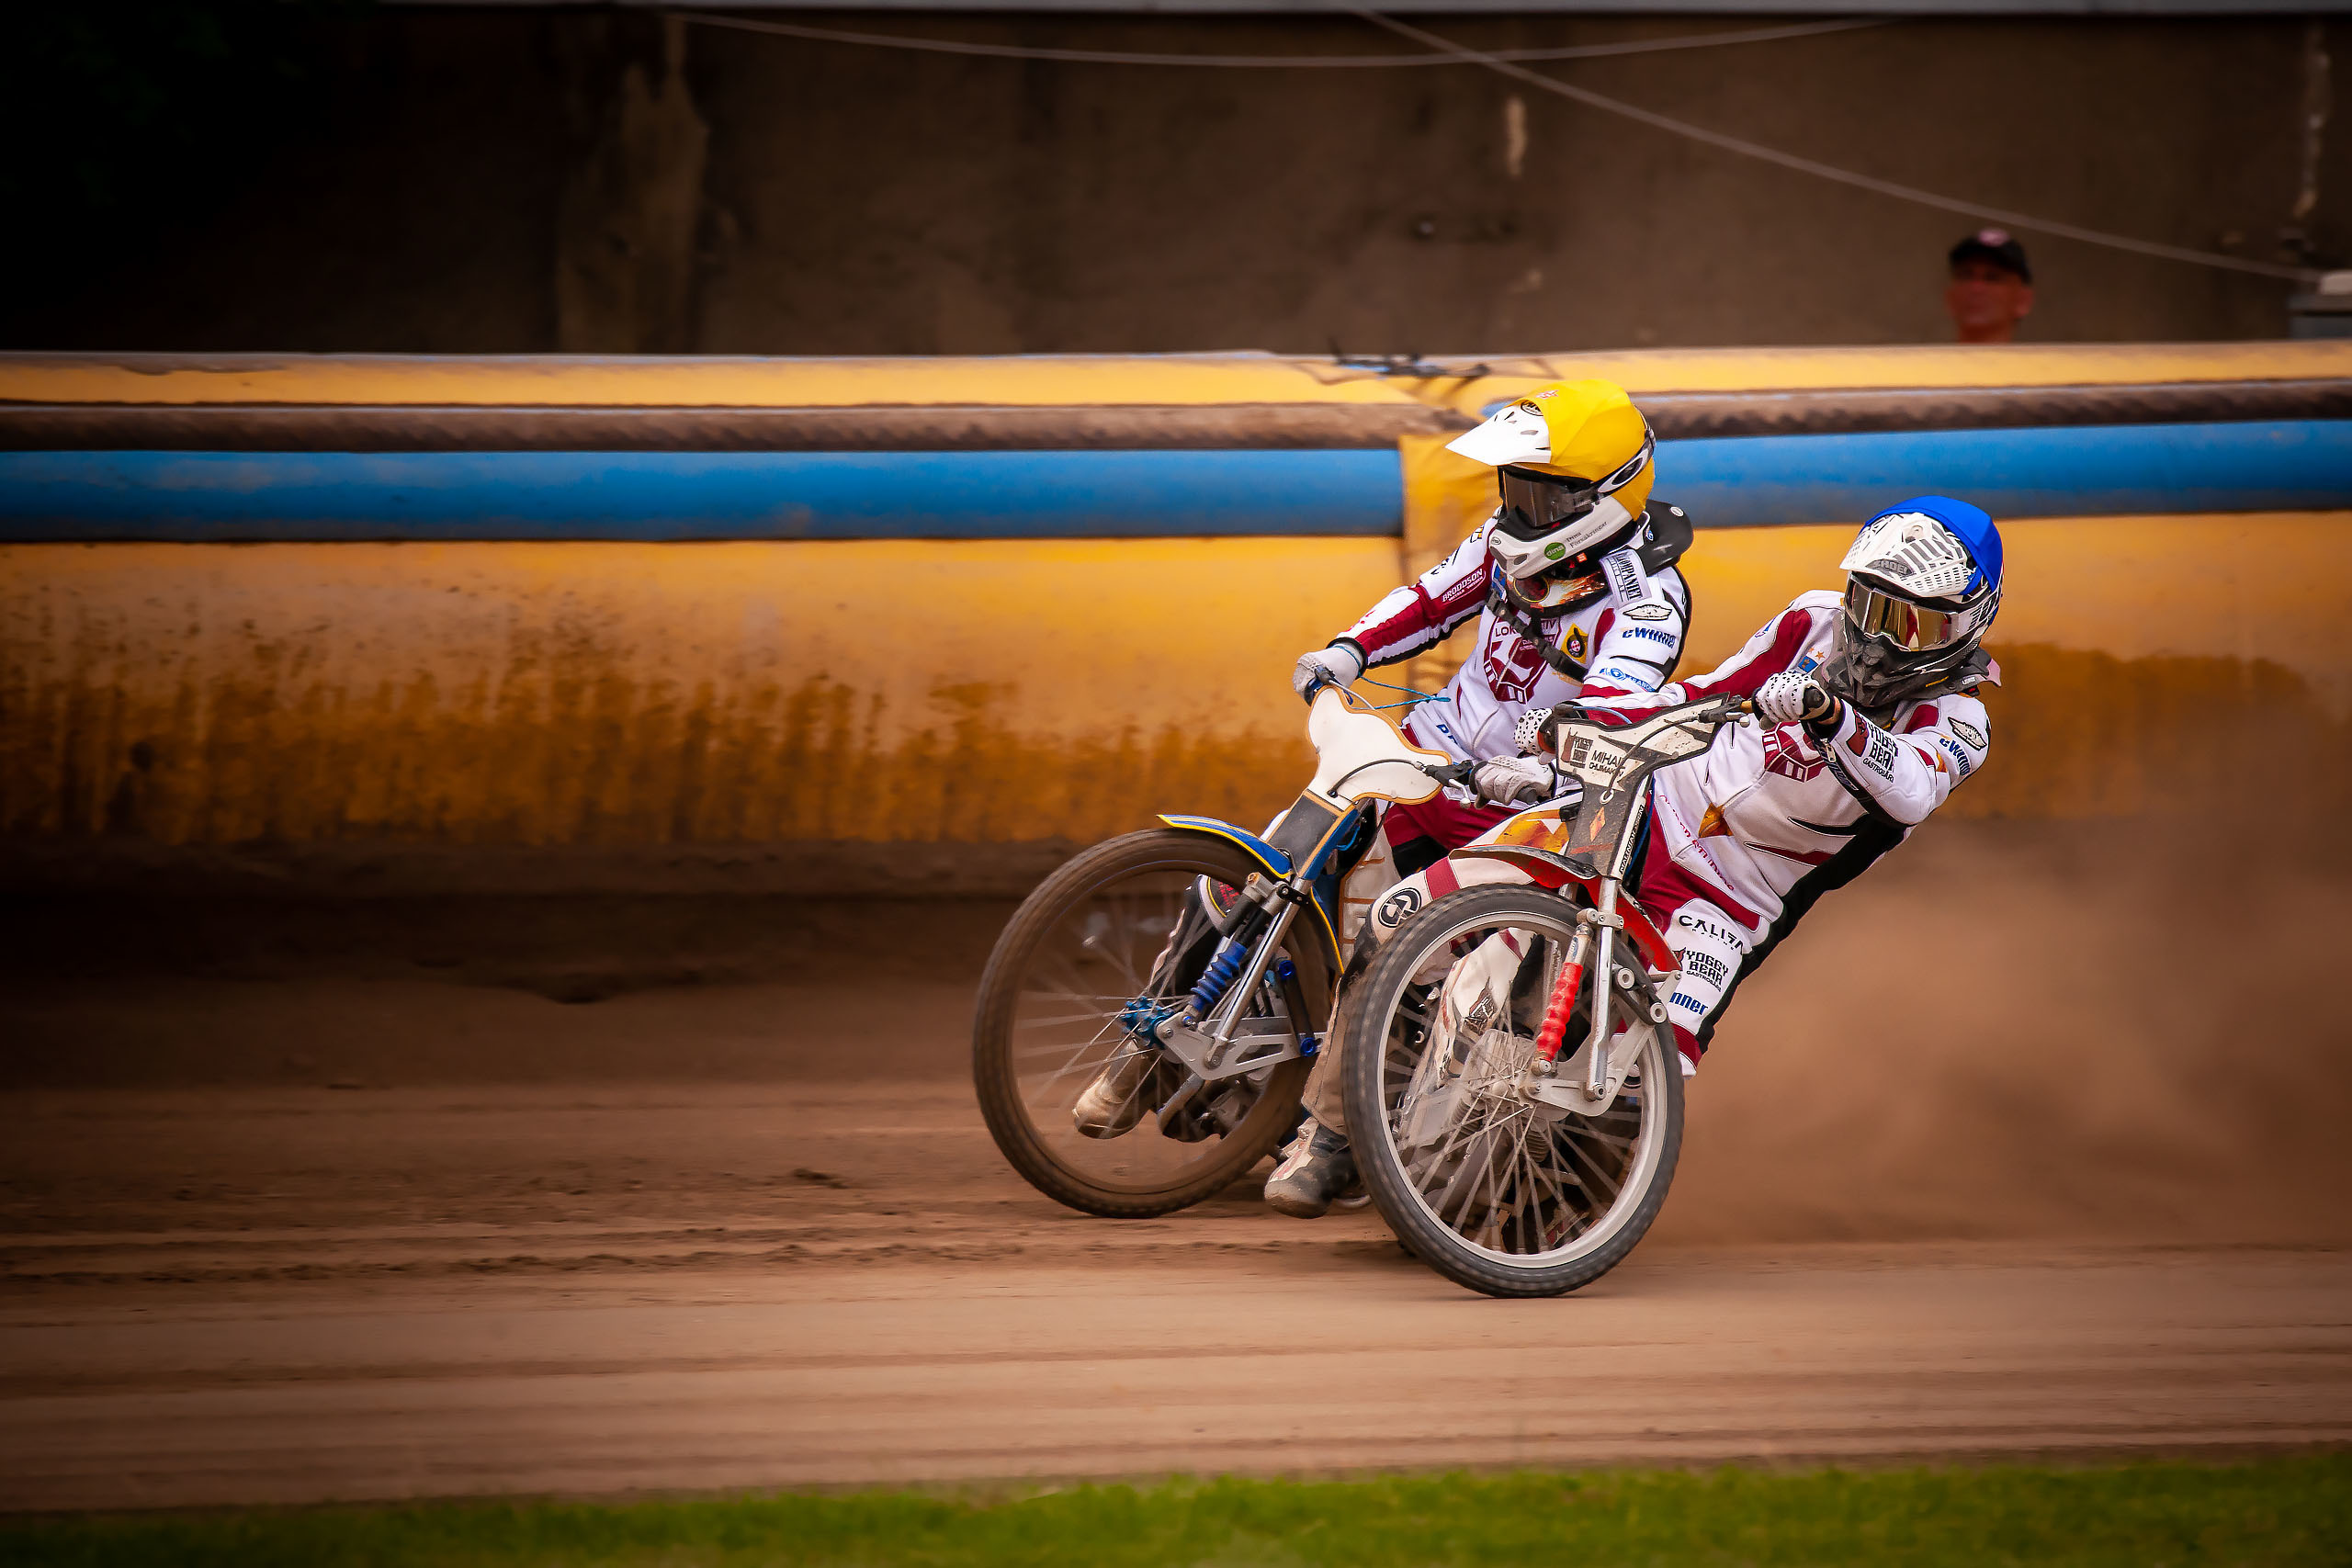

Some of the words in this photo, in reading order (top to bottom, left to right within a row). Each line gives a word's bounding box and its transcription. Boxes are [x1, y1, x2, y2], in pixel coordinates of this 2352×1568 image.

[1442, 568, 1484, 603] BRODDSON
[1686, 950, 1729, 977] YOGGY
[1689, 961, 1724, 987] BEAR
[1669, 992, 1708, 1016] nner
